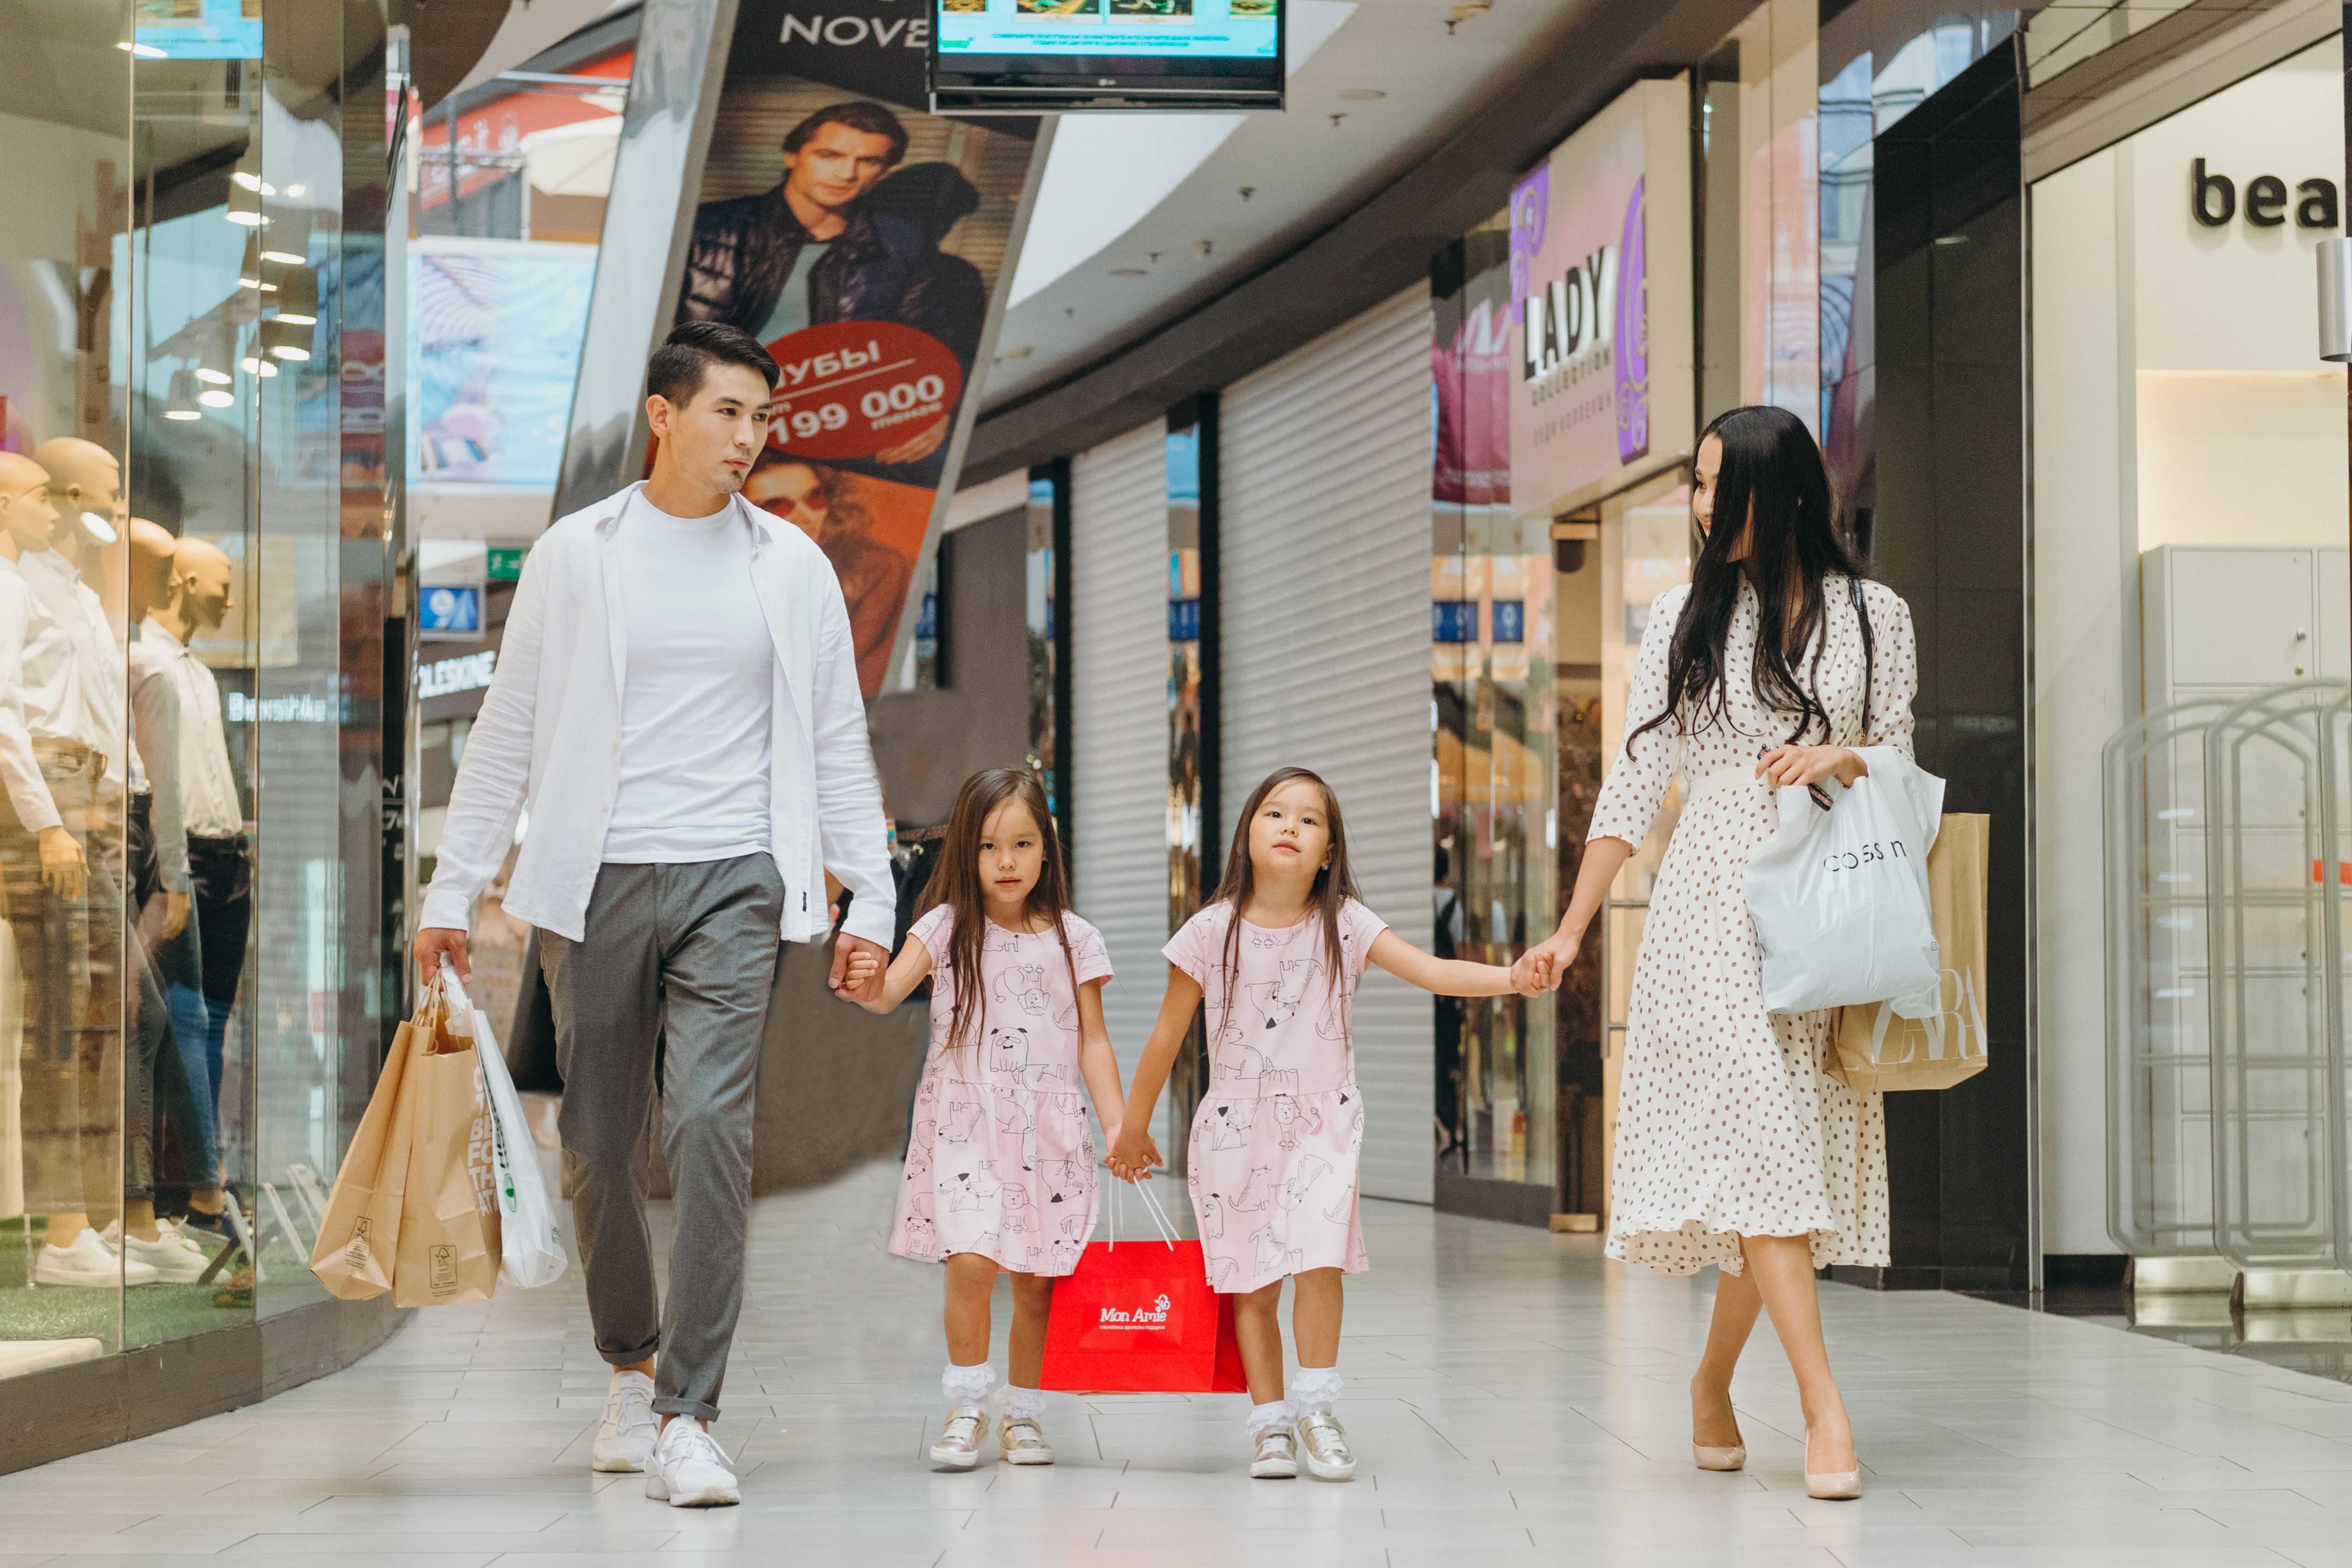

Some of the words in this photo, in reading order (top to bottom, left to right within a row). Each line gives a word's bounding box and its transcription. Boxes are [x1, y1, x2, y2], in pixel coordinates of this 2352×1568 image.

[2191, 158, 2339, 228] bea
[1524, 245, 1616, 380] LADY
[768, 402, 848, 444] 199
[860, 374, 945, 419] 000
[1100, 1308, 1130, 1322] Mon
[1131, 1307, 1167, 1322] Amie
